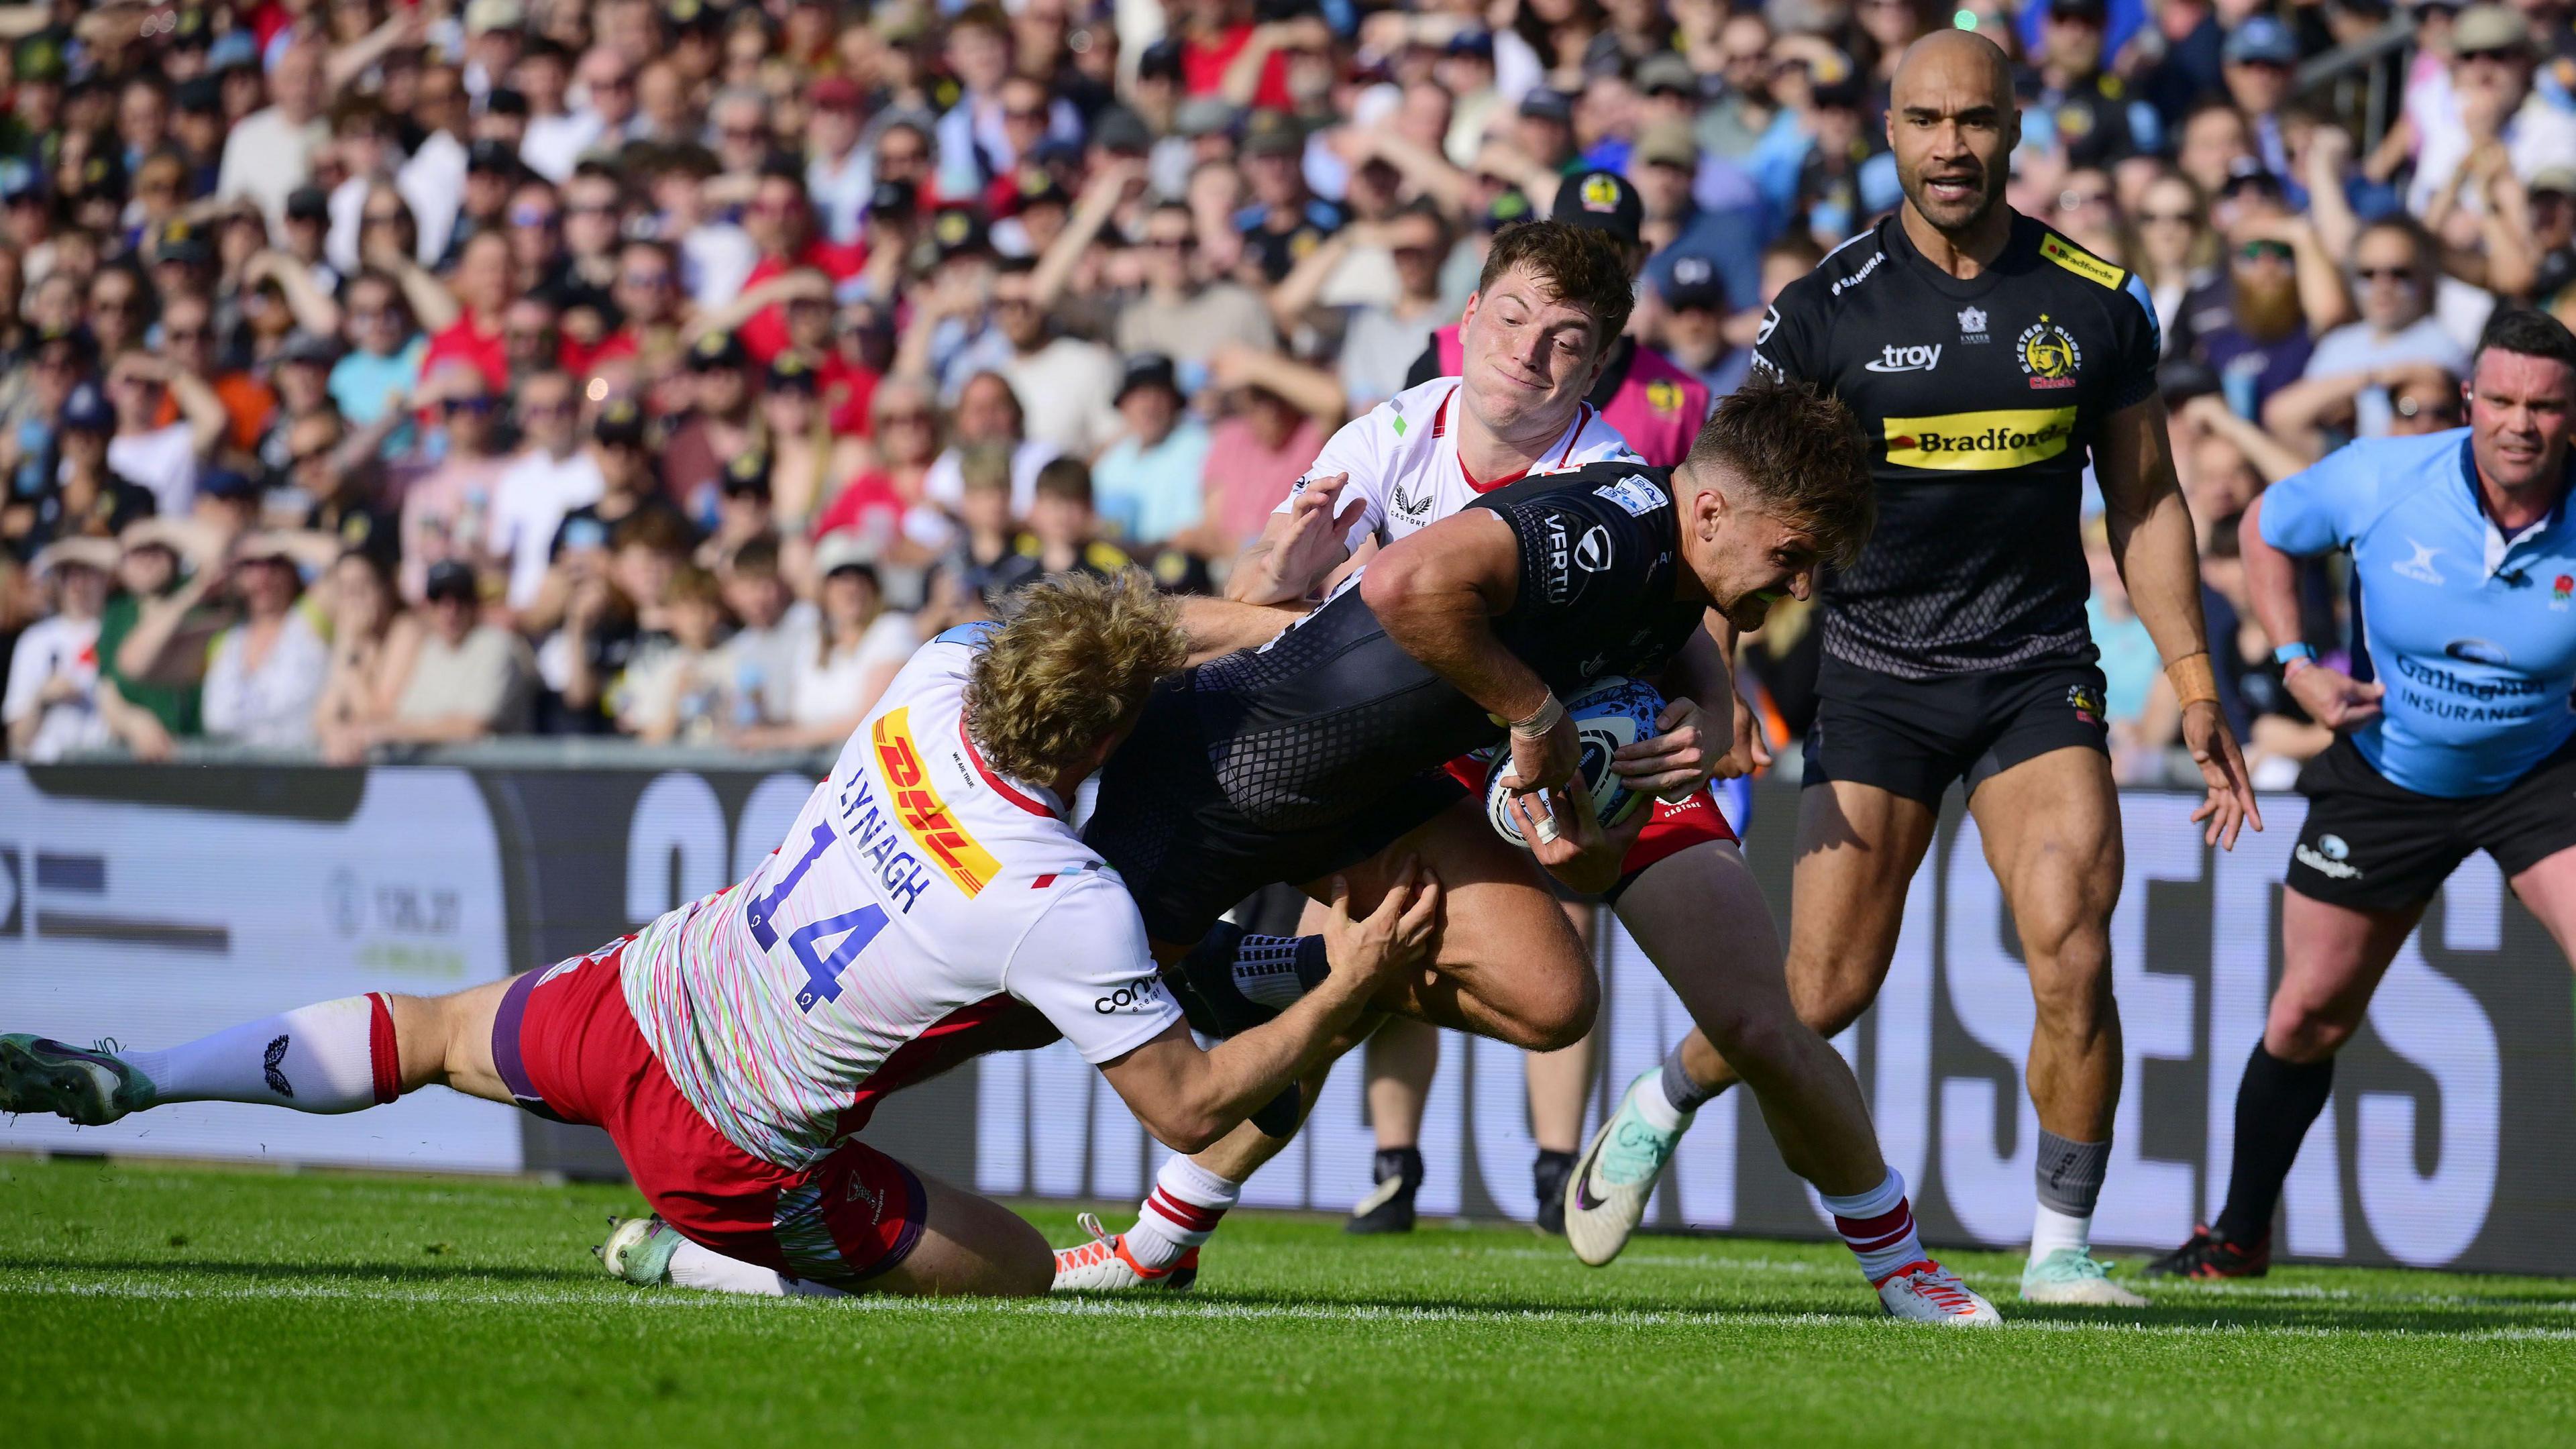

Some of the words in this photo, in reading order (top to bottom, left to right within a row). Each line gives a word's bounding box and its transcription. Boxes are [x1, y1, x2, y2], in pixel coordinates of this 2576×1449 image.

[2057, 249, 2114, 280] Bradfords
[1882, 343, 1942, 371] troy
[2017, 324, 2044, 374] EXETER
[2054, 325, 2082, 370] RUGBY
[2029, 376, 2076, 390] Chiefs
[1919, 423, 2071, 453] Bradfords
[1391, 510, 1426, 527] CASTORE
[1544, 514, 1568, 604] VERTU
[2402, 688, 2536, 723] INSURANCE
[953, 751, 961, 763] WE
[958, 762, 966, 773] ARE
[963, 772, 975, 789] TRUE
[1578, 747, 1595, 767] SHIP
[879, 736, 969, 868] DHL
[1664, 802, 1701, 818] CASTORE
[840, 767, 930, 914] LYNAGH
[747, 818, 890, 1014] 14
[1132, 987, 1161, 1012] energy
